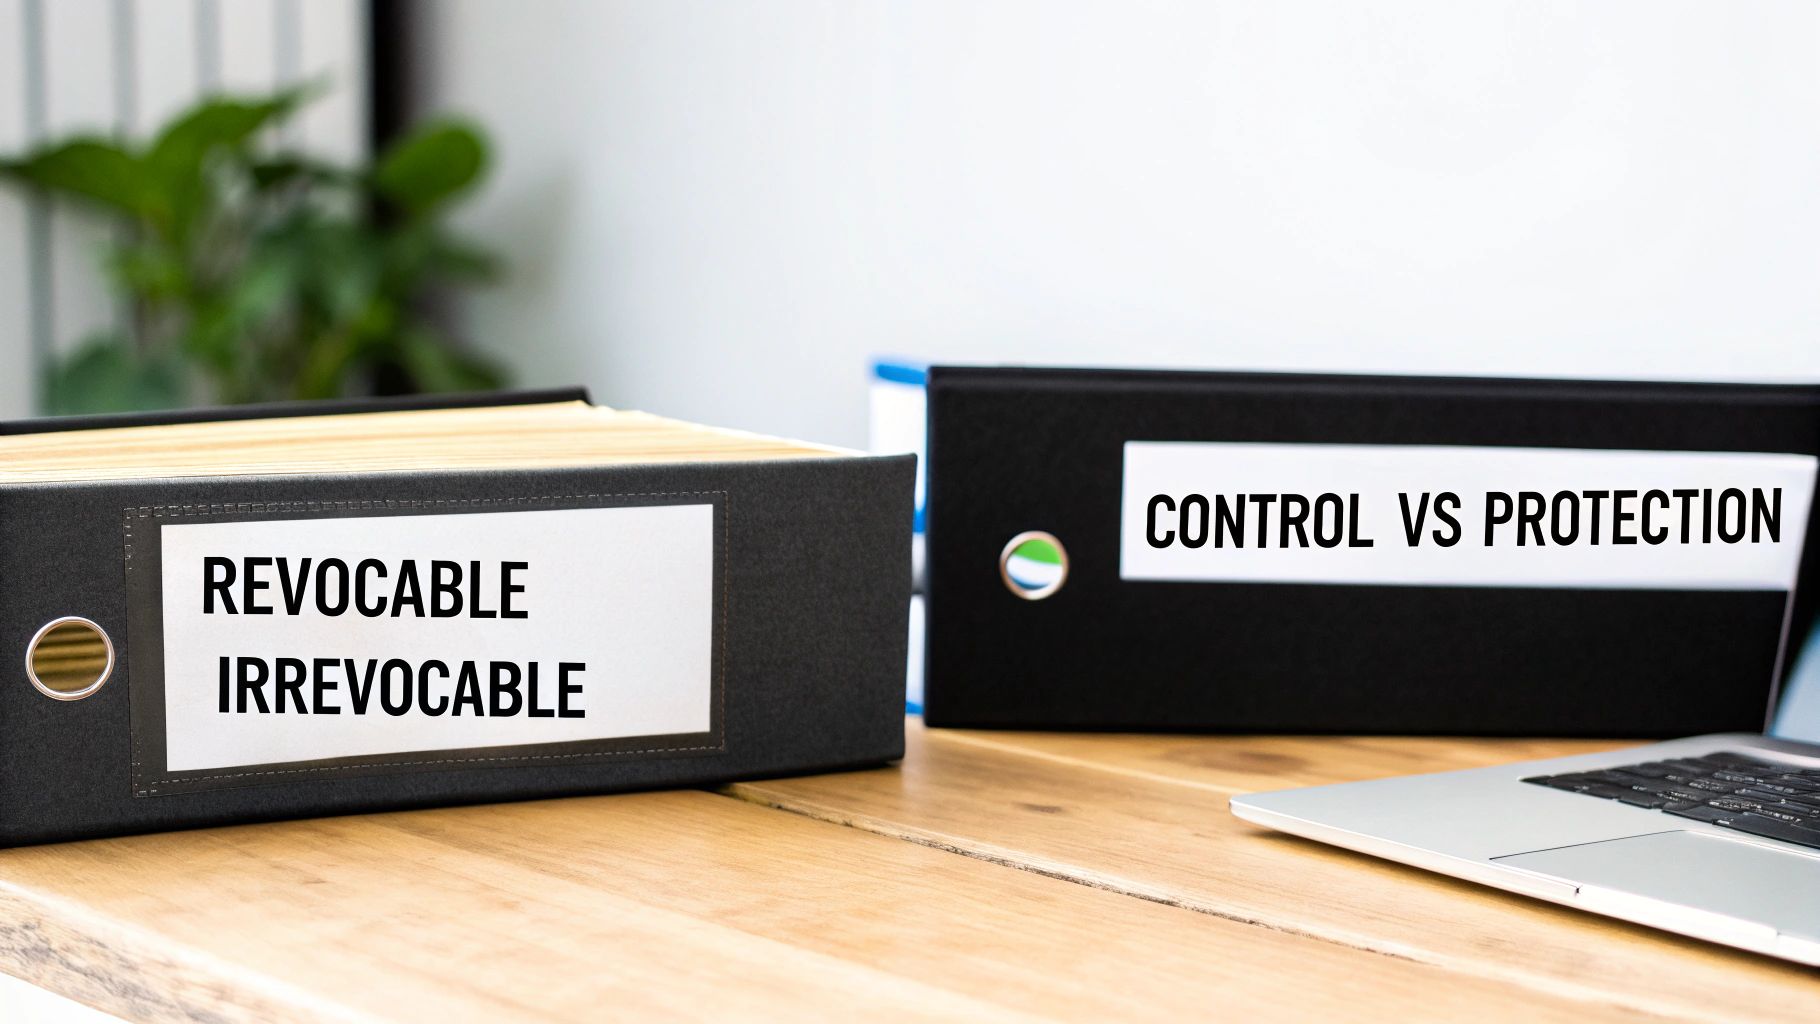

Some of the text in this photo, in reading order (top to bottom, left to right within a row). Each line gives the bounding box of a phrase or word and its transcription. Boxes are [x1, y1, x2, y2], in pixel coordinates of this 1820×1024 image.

[1146, 488, 1782, 549] CONTROL VS PROTECTION
[203, 556, 529, 619] REVOCABLE
[218, 656, 586, 718] IRREVOCABLE
